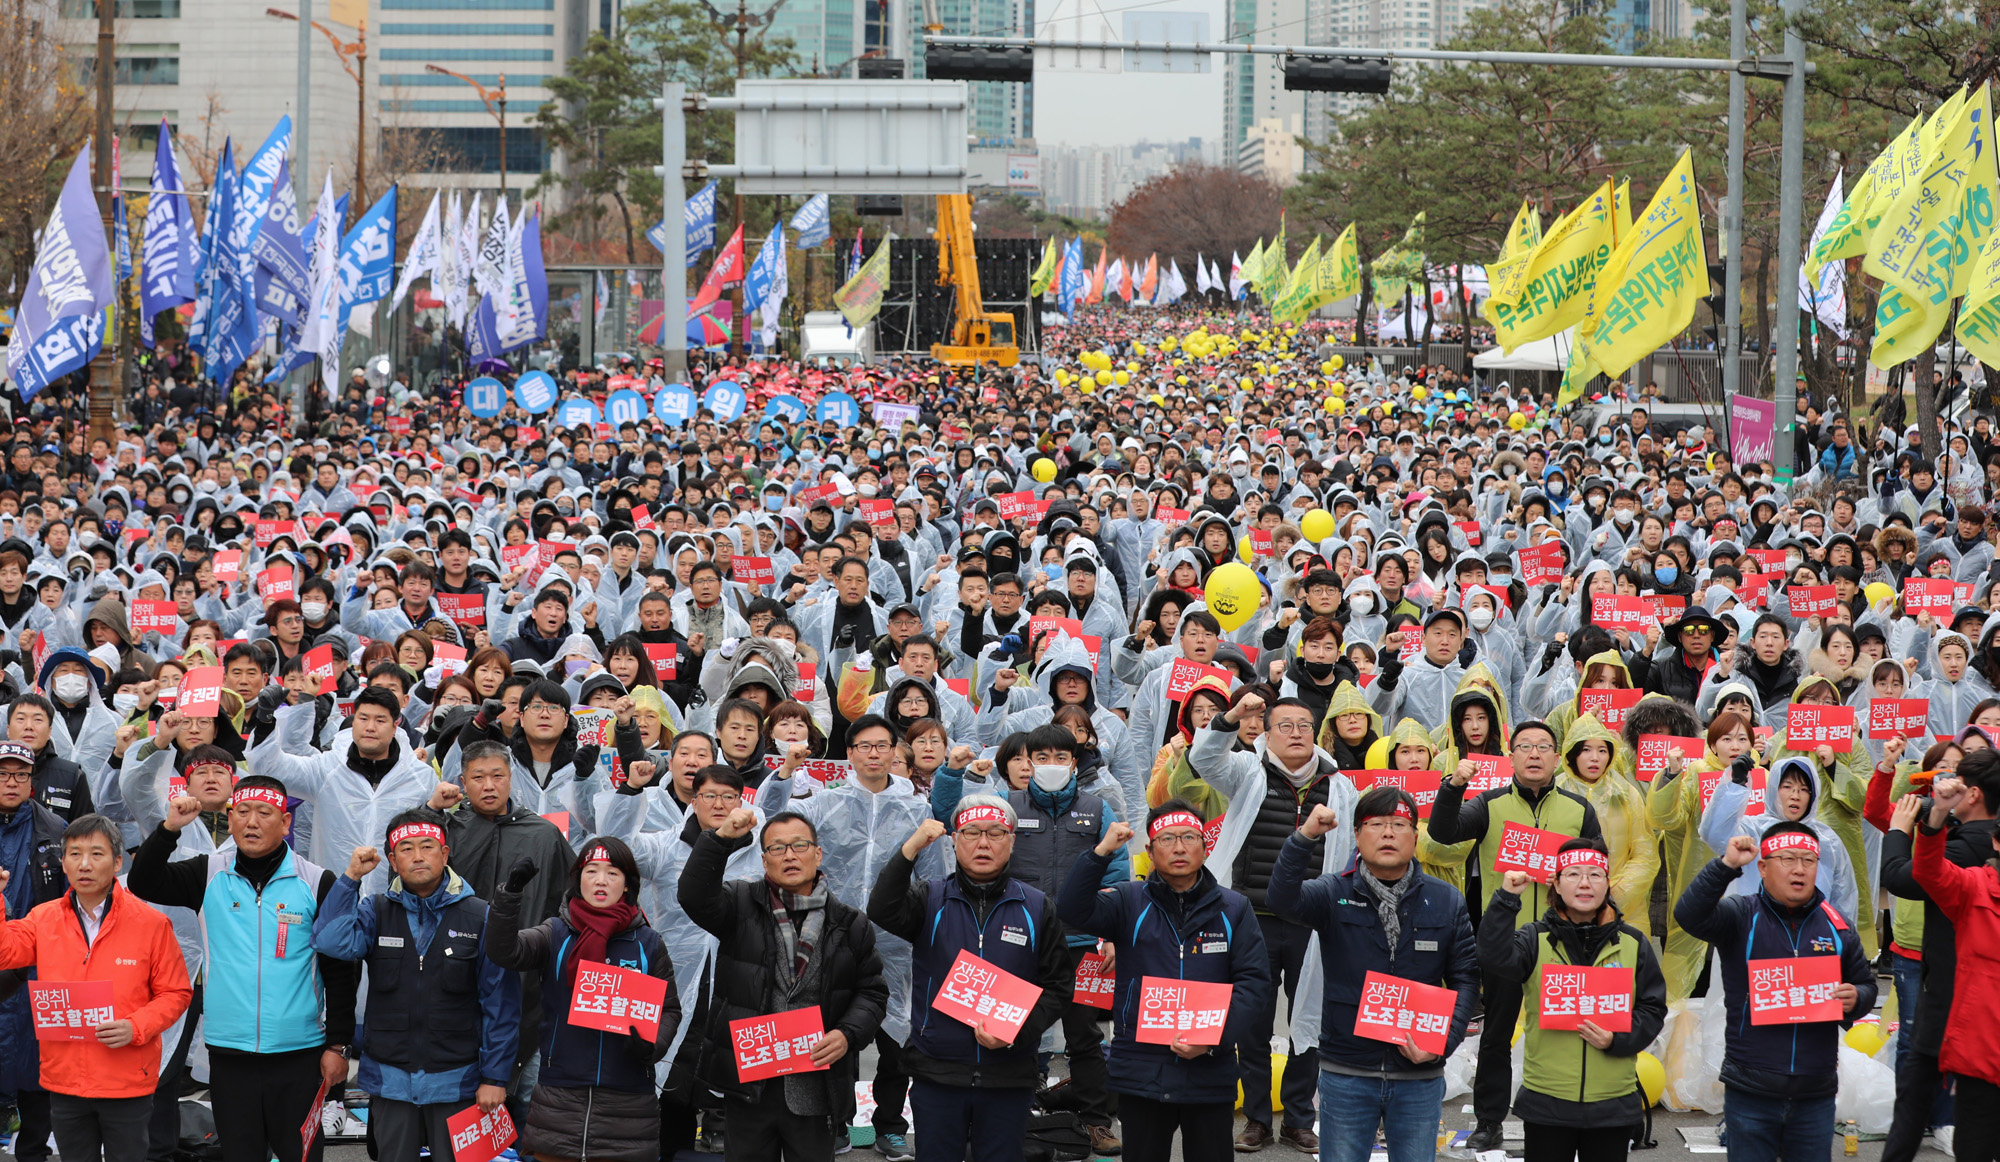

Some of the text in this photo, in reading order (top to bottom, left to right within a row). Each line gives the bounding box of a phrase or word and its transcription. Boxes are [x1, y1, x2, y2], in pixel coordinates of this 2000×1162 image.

[472, 386, 500, 411] 대
[520, 377, 551, 407] 통
[713, 387, 740, 417] 임
[612, 396, 639, 426] 이
[663, 392, 688, 418] 책
[824, 400, 852, 427] 라
[566, 407, 592, 430] 령
[1789, 590, 1811, 603] 쟁취!
[1906, 582, 1927, 596] 쟁취!
[133, 603, 154, 616] 쟁취!
[1594, 597, 1618, 611] 쟁취!
[1791, 598, 1836, 612] 노조 할 권리
[1906, 594, 1952, 607] 노조 할 권리
[132, 614, 177, 627] 노조 할 권리
[1592, 609, 1641, 622] 노조 할 권리
[655, 657, 675, 671] 권리
[1173, 664, 1201, 682] 쟁취!
[193, 686, 220, 704] 권리
[1790, 709, 1821, 727] 쟁취!
[1872, 703, 1899, 718] 쟁취!
[1789, 724, 1853, 741] 노조 할 권리
[1871, 714, 1928, 731] 노조 할 권리
[1639, 757, 1663, 771] 노조
[1490, 776, 1502, 790] 할
[234, 788, 284, 807] 단결 투쟁
[1415, 790, 1439, 806] 권리
[959, 809, 977, 825] 단결
[1153, 814, 1174, 832] 단결
[391, 824, 441, 843] 단결 투쟁
[1504, 829, 1540, 851] 쟁취!
[1768, 836, 1789, 851] 단결
[1498, 847, 1557, 872] 노조 할 권
[1560, 851, 1580, 867] 단결
[579, 971, 623, 995] 쟁취!
[953, 960, 998, 994] 쟁취!
[1090, 978, 1100, 993] 할
[1544, 973, 1586, 996] 쟁취!
[1752, 965, 1795, 992] 쟁취!
[33, 989, 71, 1010] 쟁취!
[941, 981, 1029, 1026] 노조 할 권리
[1144, 987, 1187, 1010] 쟁취!
[1366, 981, 1410, 1007] 쟁취!
[1543, 993, 1631, 1016] 노조 할 권리
[1753, 981, 1840, 1012] 노조 할 권리
[36, 1005, 114, 1028] 노조 할 권리
[573, 994, 661, 1024] 노조 할 권리
[1141, 1008, 1226, 1031] 노조 할 권리
[1360, 1004, 1450, 1036] 노조 할 권리
[735, 1021, 778, 1050] 쟁취!
[740, 1045, 774, 1070] 노조
[773, 1040, 791, 1061] 할
[453, 1113, 493, 1153] 할 권리
[491, 1115, 514, 1151] 쟁취!
